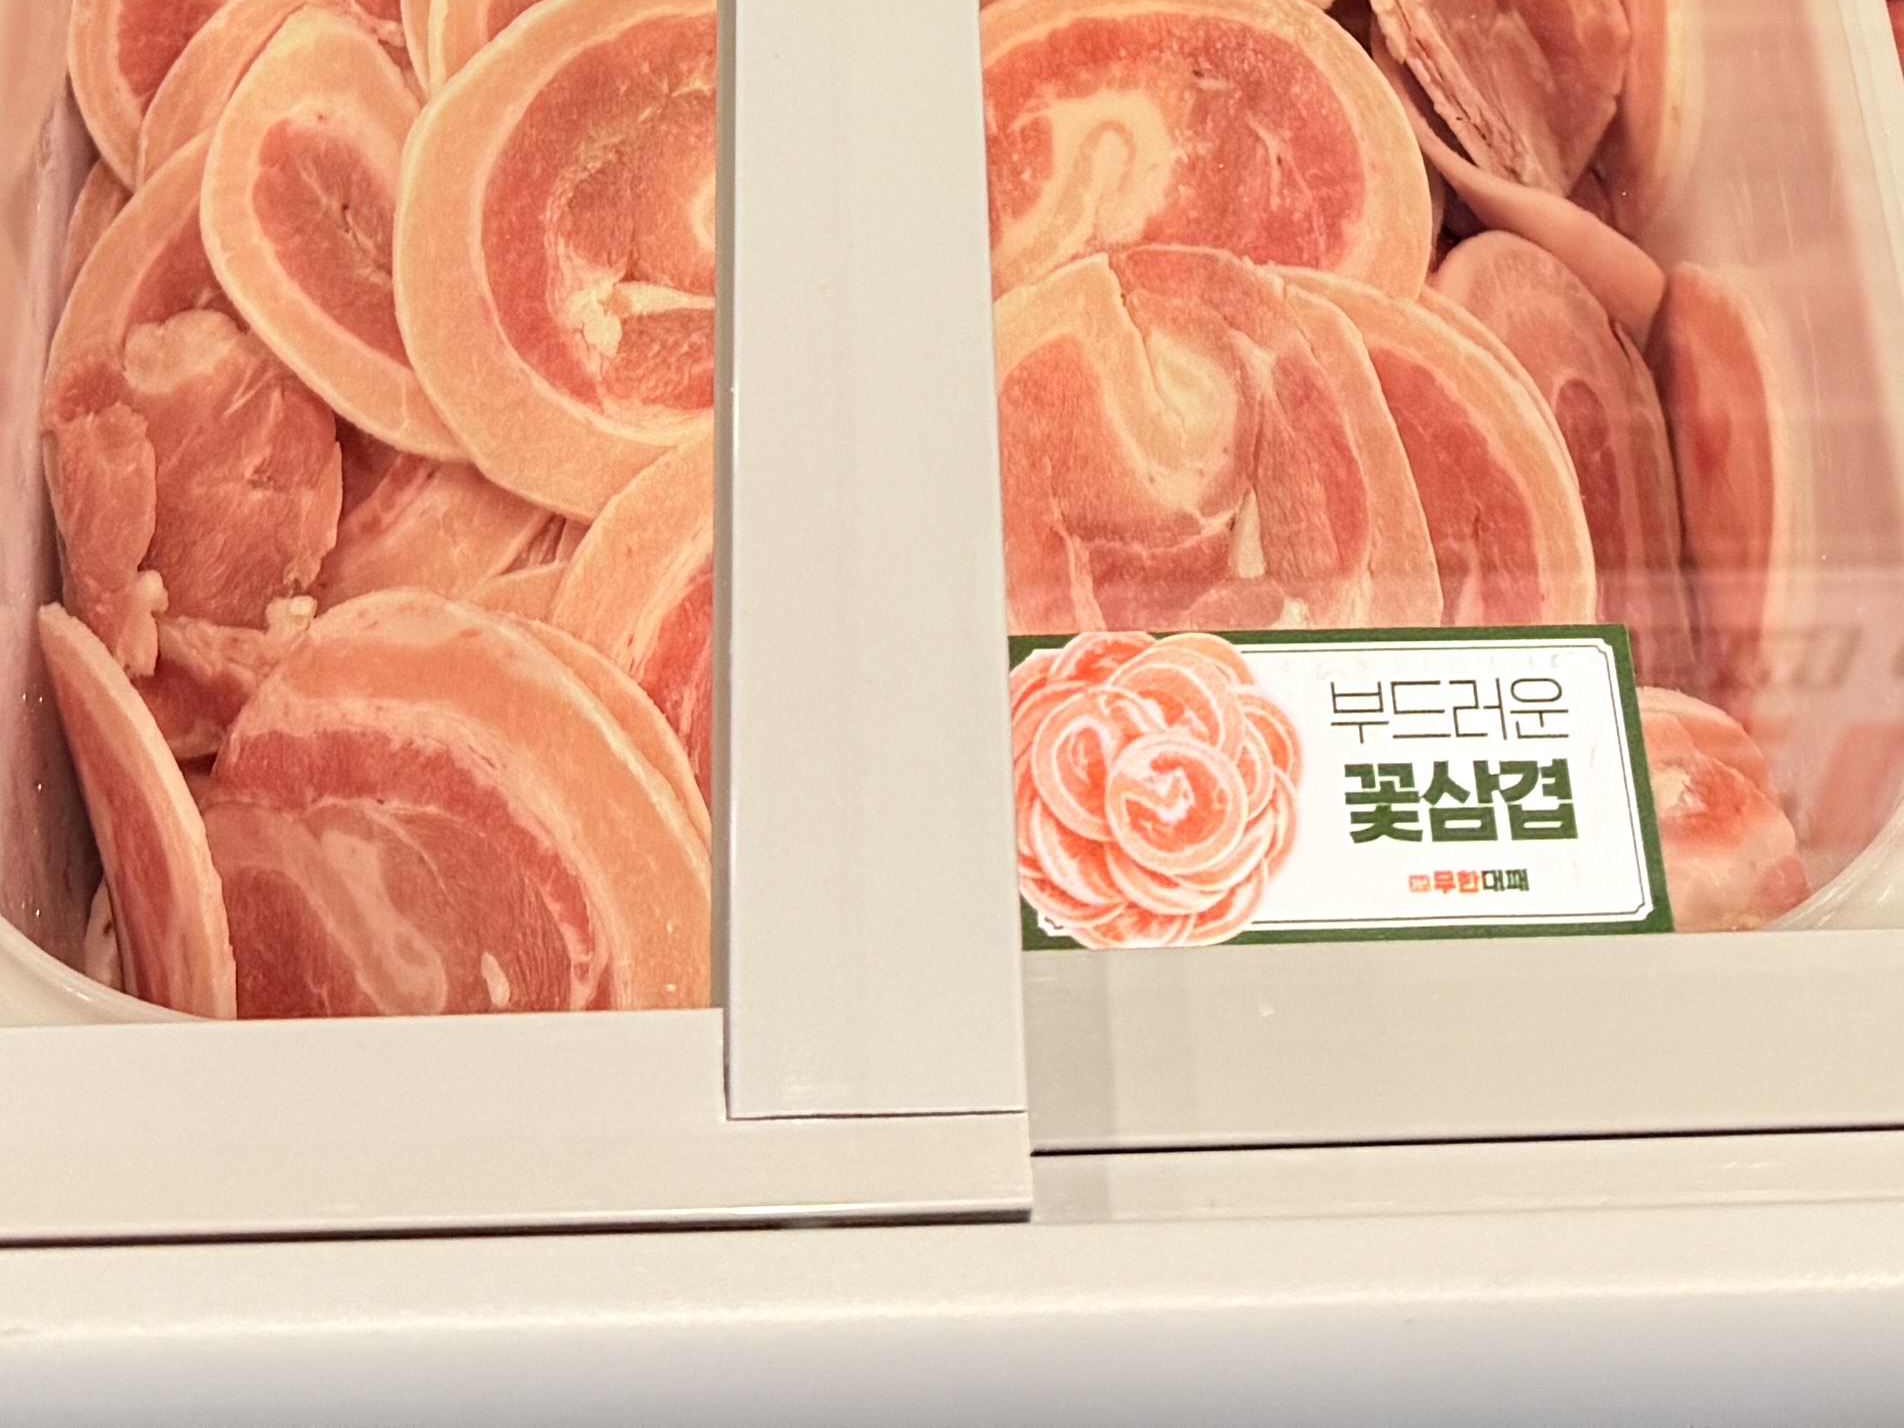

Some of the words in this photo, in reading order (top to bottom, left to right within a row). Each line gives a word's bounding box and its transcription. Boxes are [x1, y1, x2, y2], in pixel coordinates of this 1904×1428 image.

[1329, 676, 1570, 745] 부드러운
[1343, 757, 1579, 845] 꽃삼겹
[1432, 868, 1530, 895] 무한대패
